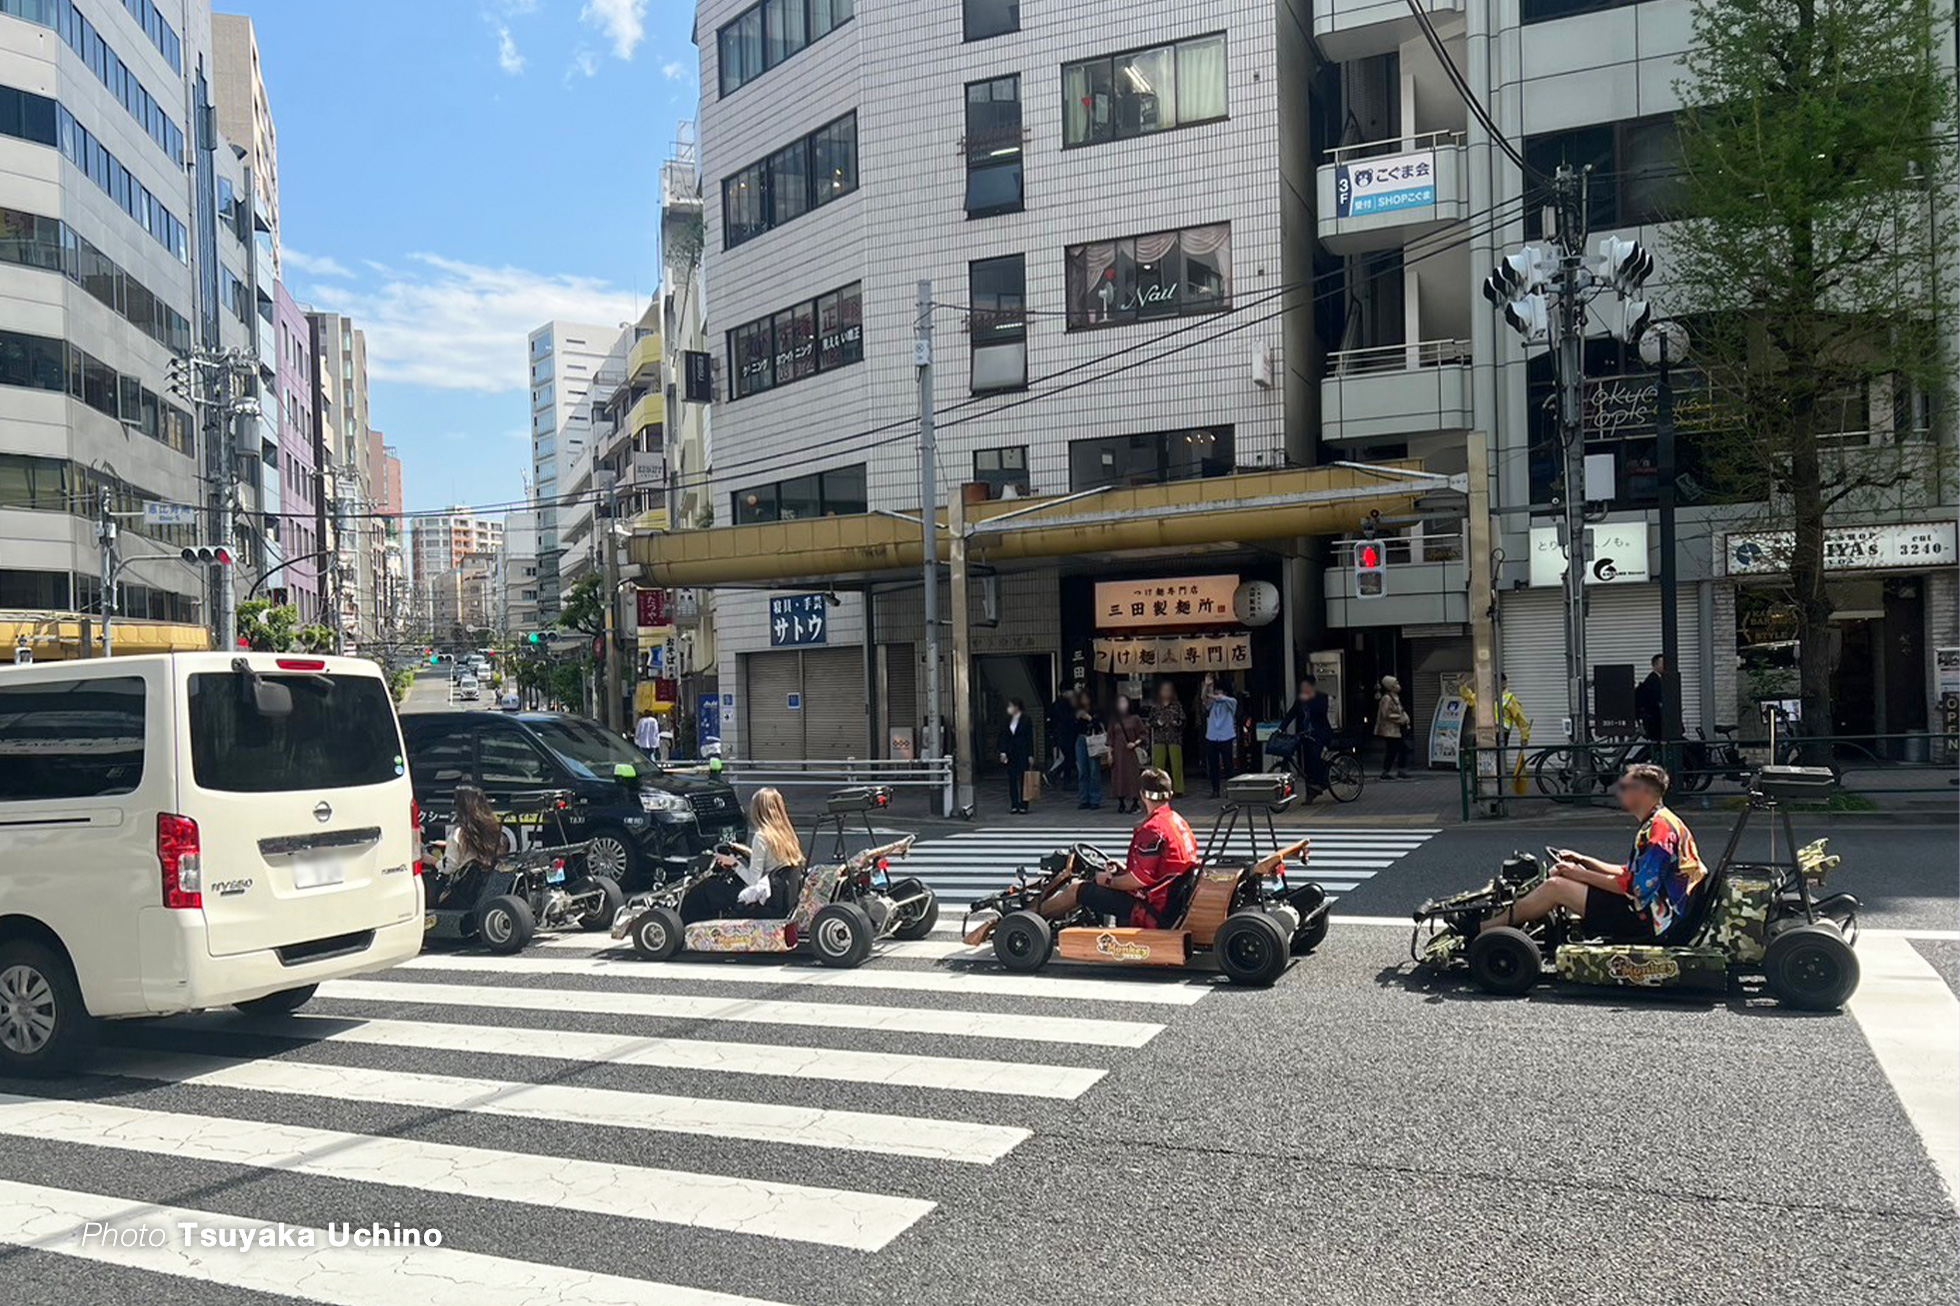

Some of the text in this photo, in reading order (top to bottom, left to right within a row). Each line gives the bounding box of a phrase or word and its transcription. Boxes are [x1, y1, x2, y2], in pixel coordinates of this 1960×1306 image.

[1376, 162, 1430, 183] こぐま会
[1378, 190, 1431, 207] SHOPこぐま
[1120, 282, 1178, 310] Nail
[1912, 534, 1931, 542] cut
[1108, 598, 1214, 617] 三田製麺所
[774, 614, 823, 643] サトウ
[569, 816, 586, 824] TAXI
